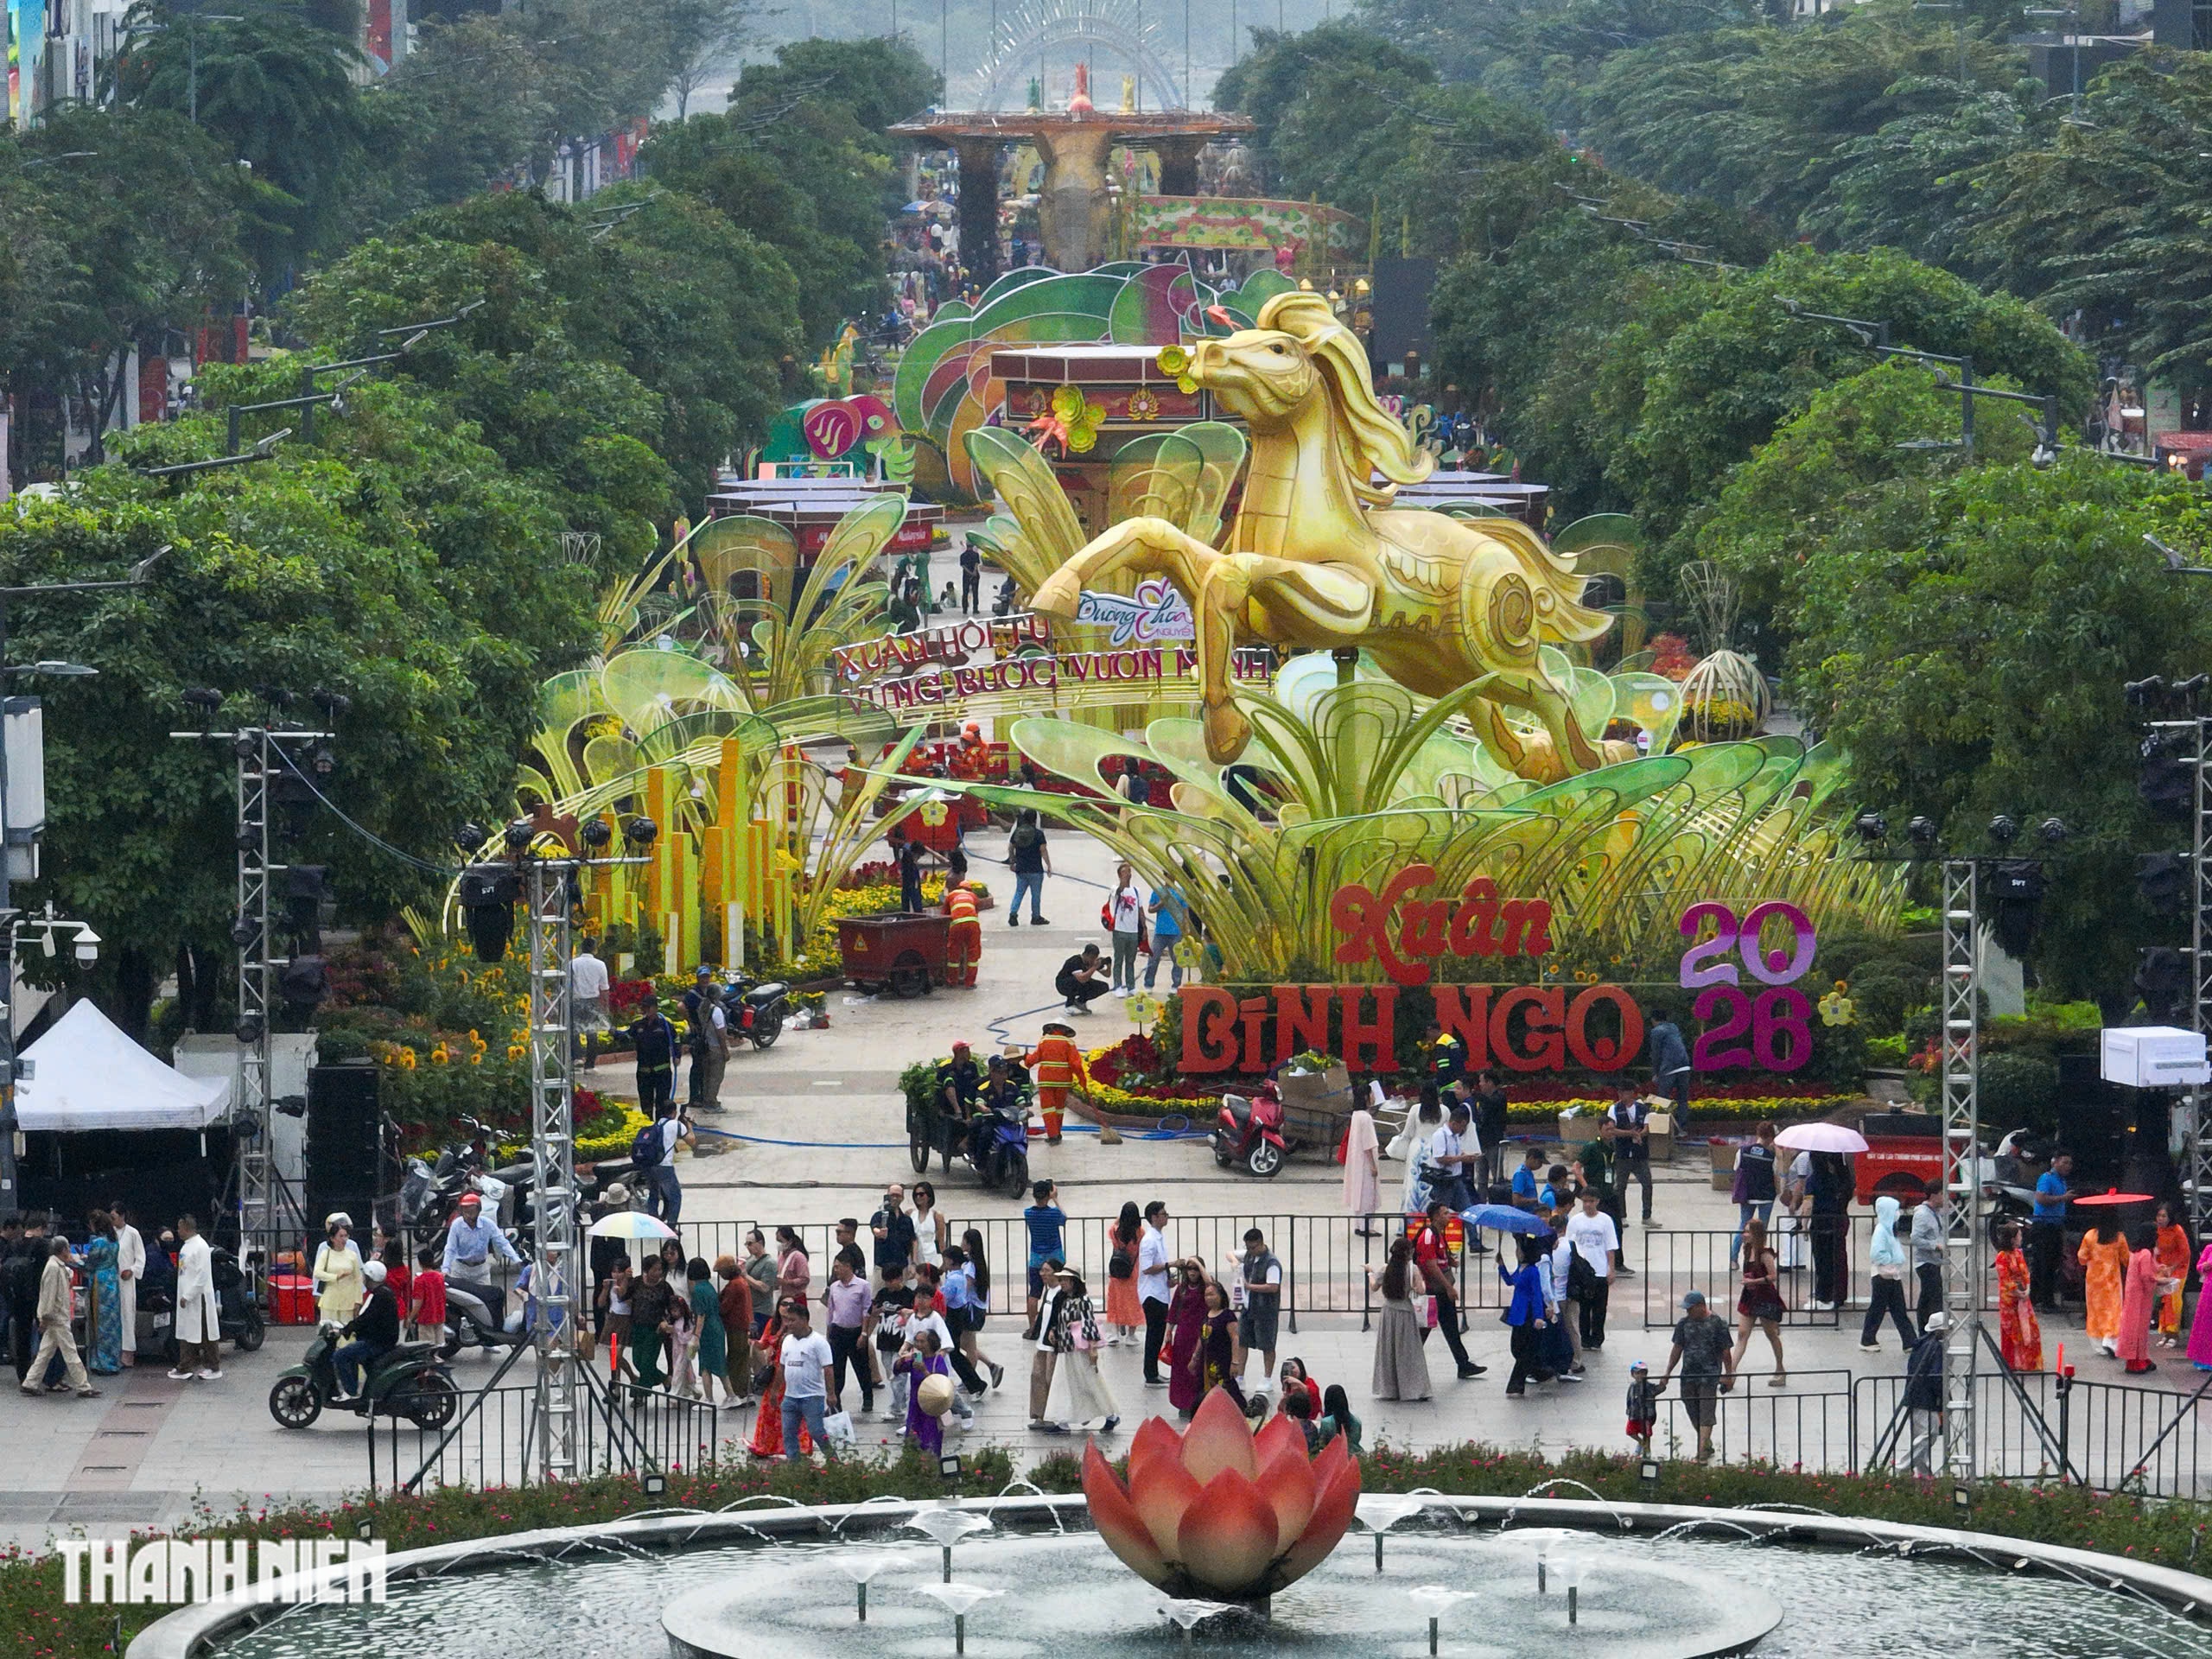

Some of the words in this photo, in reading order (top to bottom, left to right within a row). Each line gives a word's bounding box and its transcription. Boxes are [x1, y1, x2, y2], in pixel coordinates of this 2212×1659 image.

[831, 632, 931, 678] XUÂN
[951, 654, 1057, 697] BƯỚC
[1331, 864, 1552, 987] Xuân
[1680, 900, 1816, 988] 20
[1176, 984, 1401, 1072] BÍNH
[1693, 985, 1812, 1071] 26
